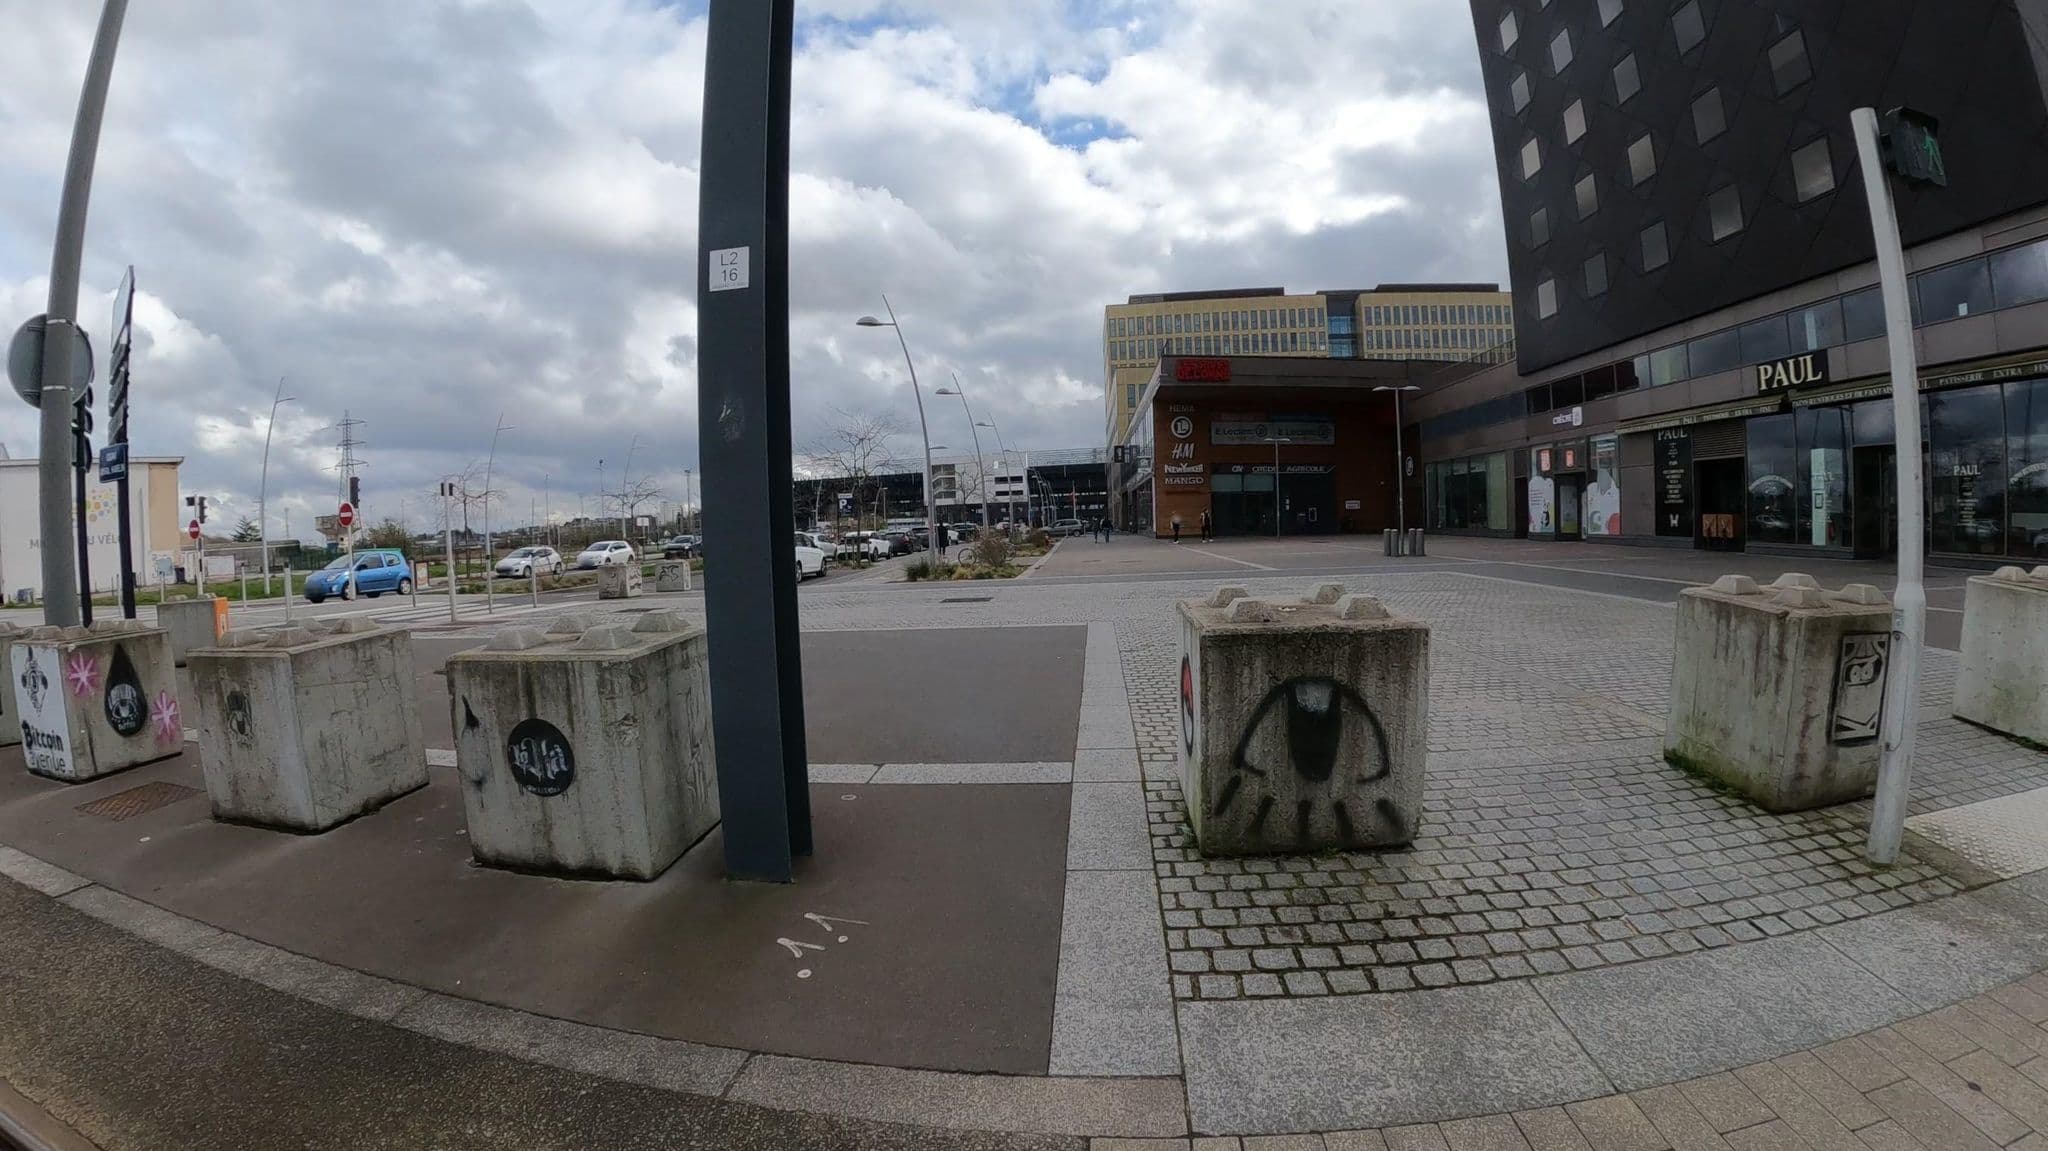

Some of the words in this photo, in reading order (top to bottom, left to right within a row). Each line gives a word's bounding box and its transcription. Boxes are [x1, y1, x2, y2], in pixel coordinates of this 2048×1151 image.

[720, 252, 738, 266] L2
[721, 268, 738, 282] 16
[1758, 354, 1823, 391] PAUL
[1993, 367, 2022, 379] EXTRA
[2034, 361, 2048, 373] FIN
[1657, 427, 1688, 441] PAUL
[1953, 463, 1982, 477] PAUL
[1164, 476, 1204, 484] MANGO
[97, 532, 119, 546] VÉL
[22, 719, 65, 752] Bitcoin
